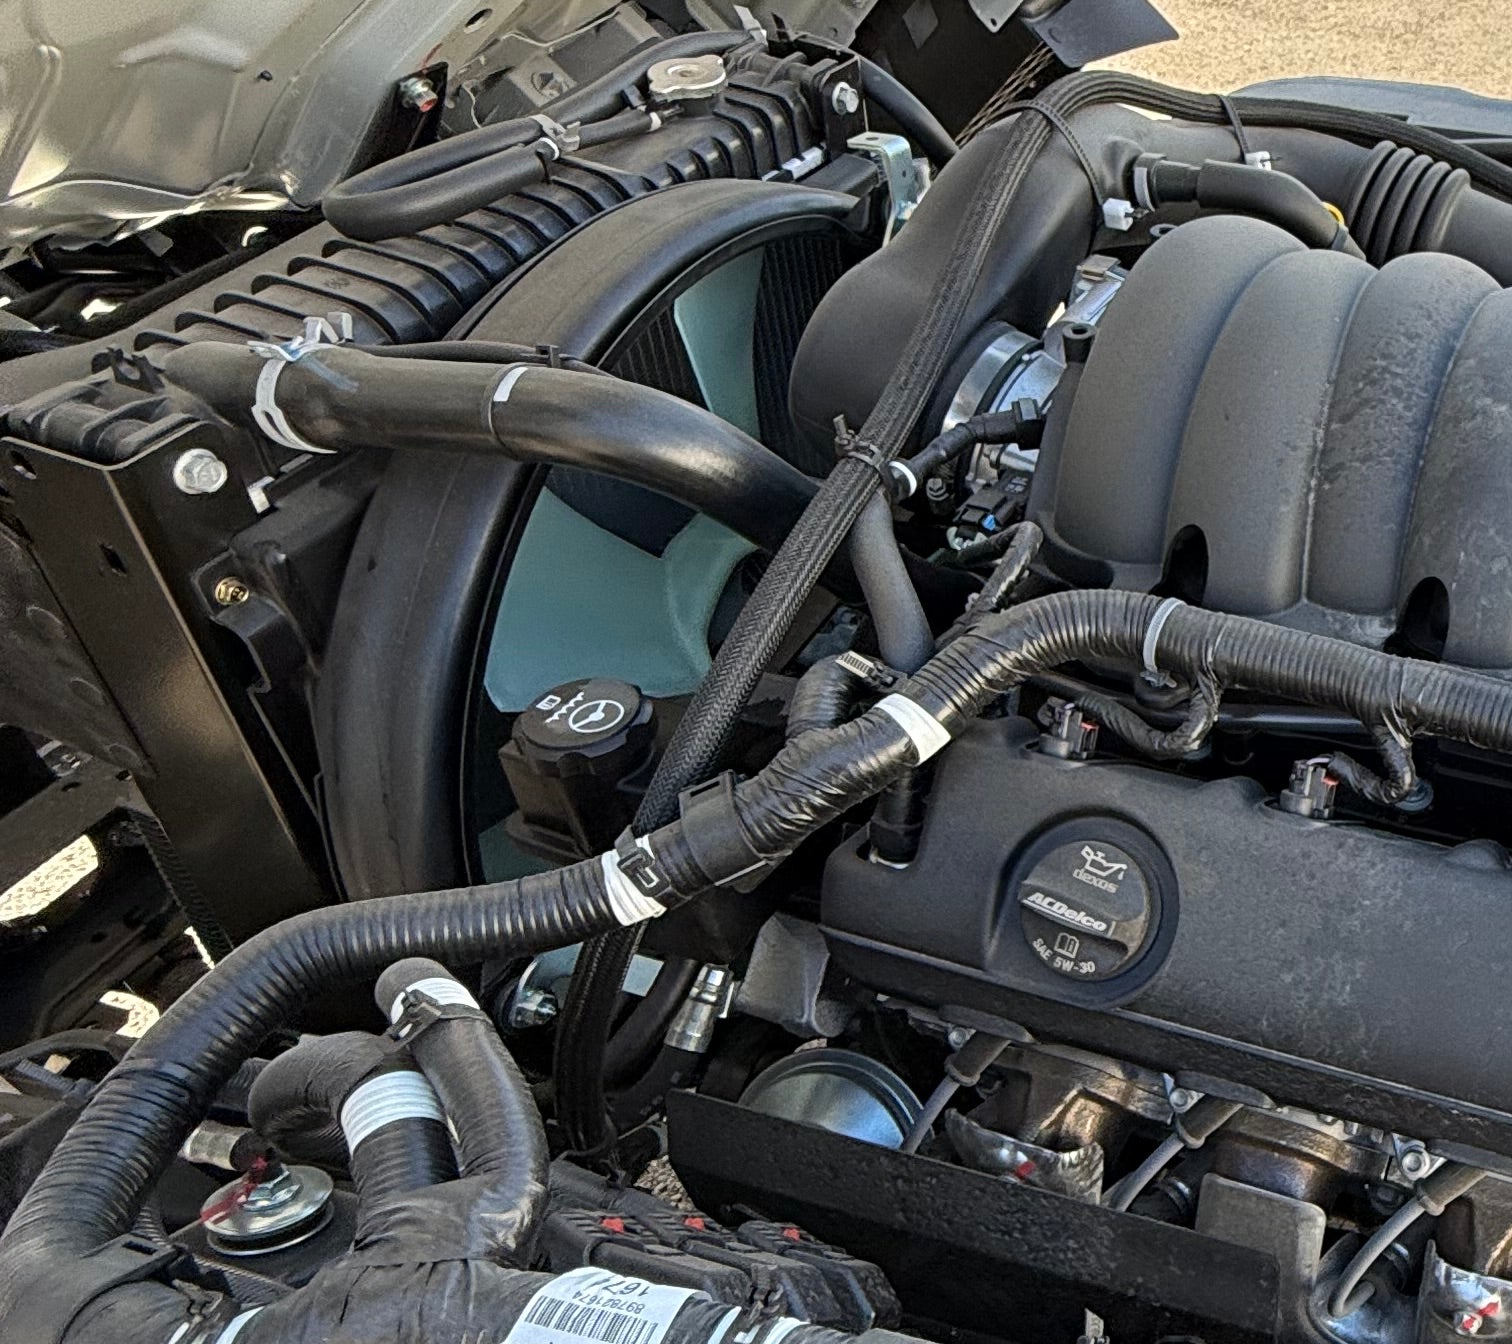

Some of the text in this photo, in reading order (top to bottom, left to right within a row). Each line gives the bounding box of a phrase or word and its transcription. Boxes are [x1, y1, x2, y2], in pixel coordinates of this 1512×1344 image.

[1072, 868, 1119, 894] dexos
[1026, 892, 1107, 932] ACDelco
[1032, 938, 1096, 974] SAE 5W-30
